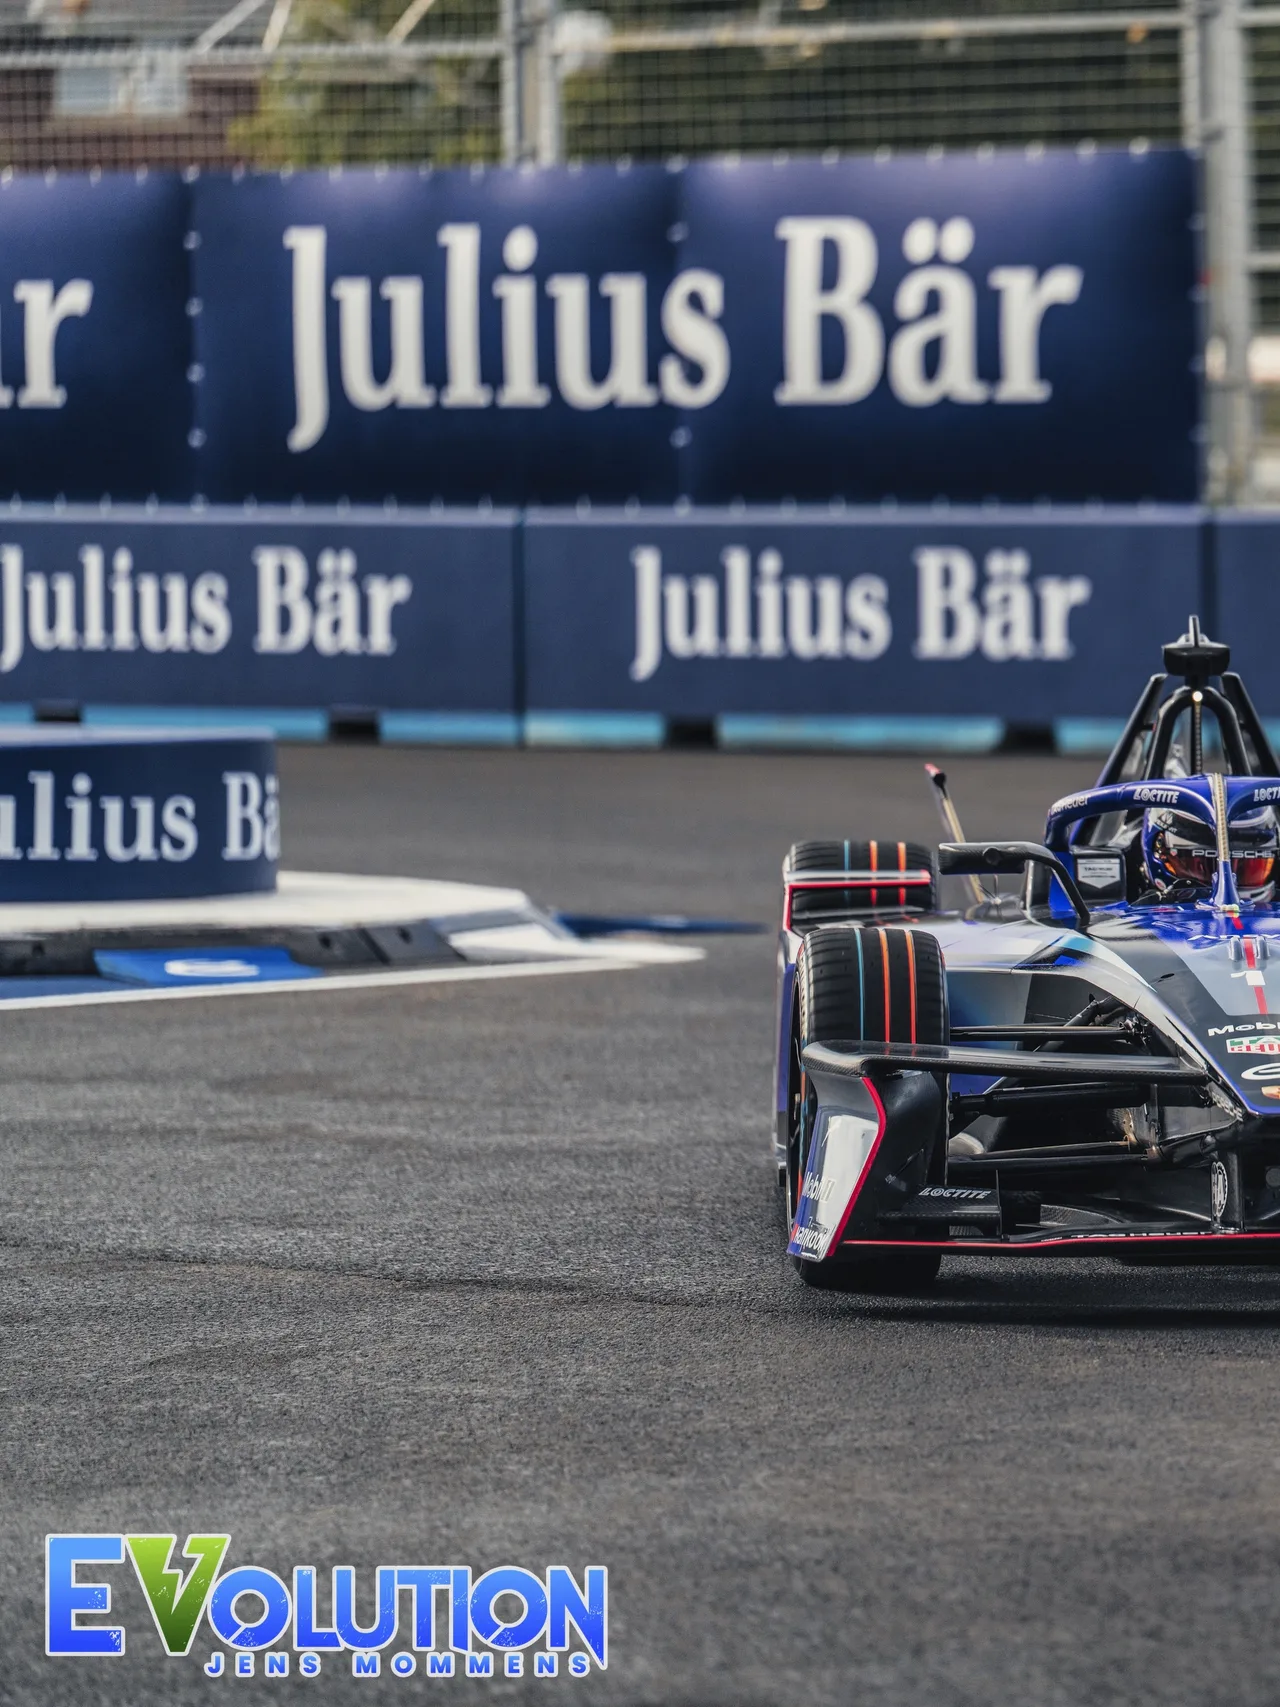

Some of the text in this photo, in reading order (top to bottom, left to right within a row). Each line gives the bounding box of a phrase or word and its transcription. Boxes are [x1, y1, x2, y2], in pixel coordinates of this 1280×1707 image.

[0, 279, 94, 409] r
[283, 215, 1083, 452] Julius Bär
[0, 545, 412, 673] Julius Bär
[630, 546, 1092, 681] Julius Bär
[1133, 788, 1180, 803] LOCTITE
[1192, 850, 1273, 858] POSCHE
[918, 1187, 992, 1199] LOCTITE
